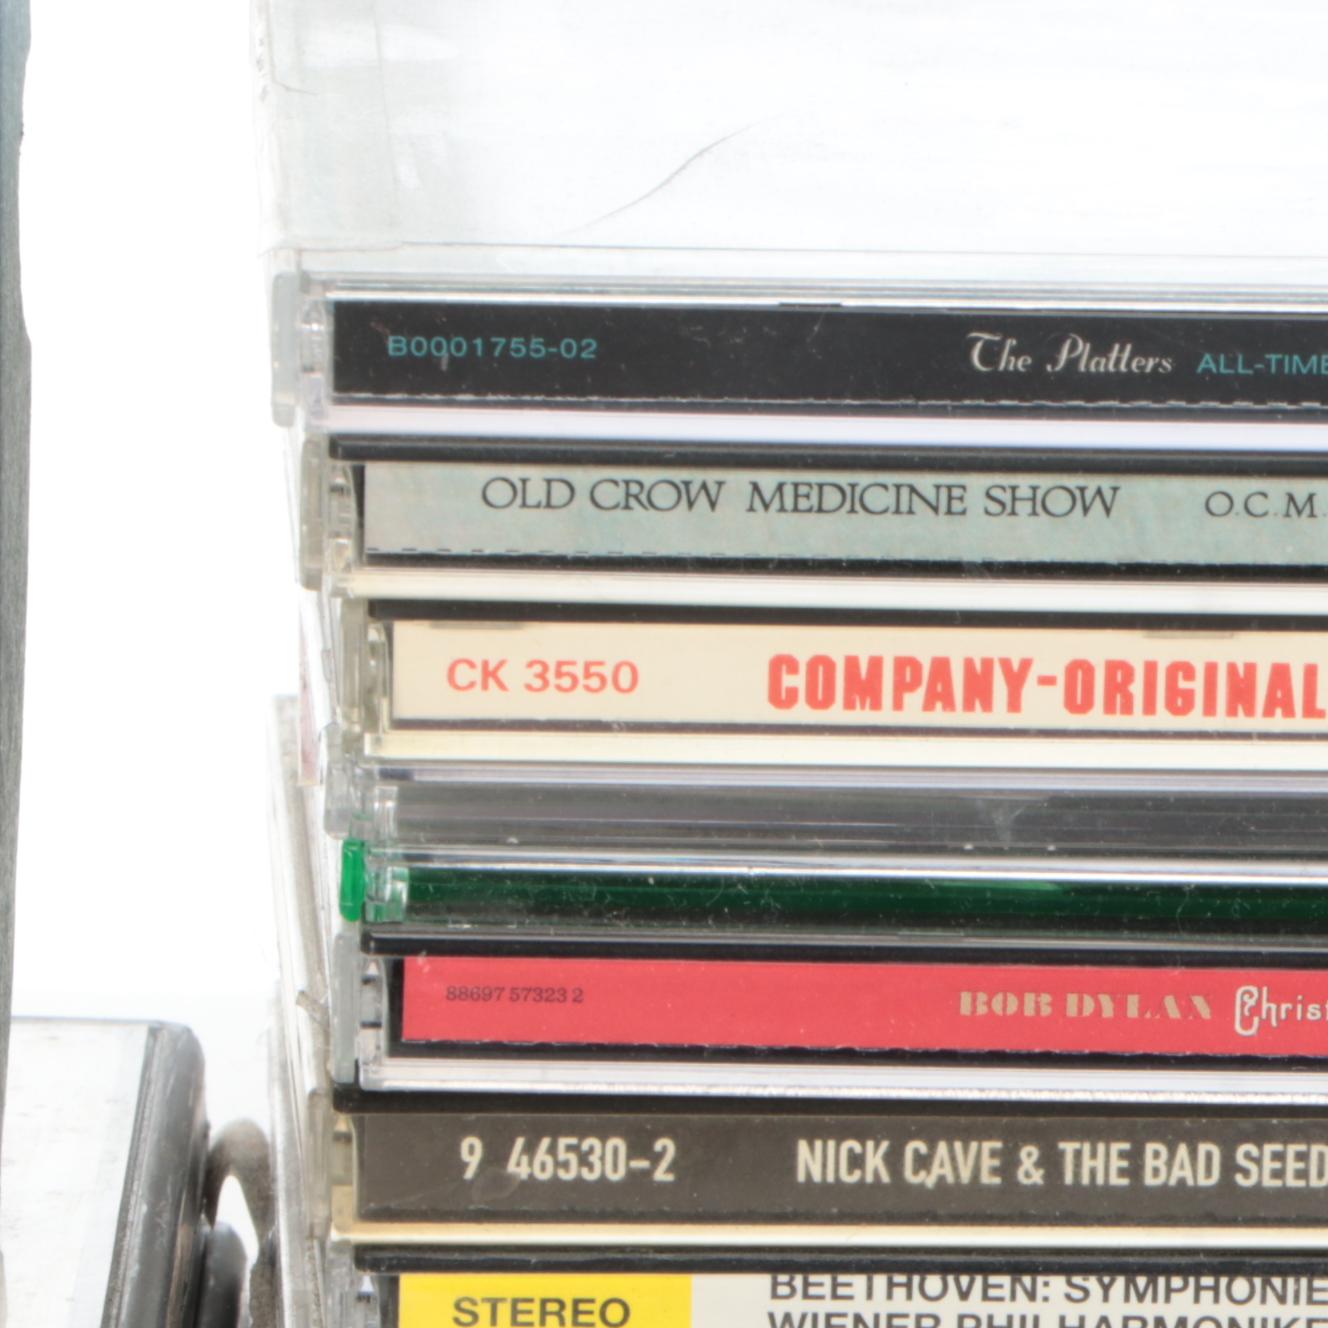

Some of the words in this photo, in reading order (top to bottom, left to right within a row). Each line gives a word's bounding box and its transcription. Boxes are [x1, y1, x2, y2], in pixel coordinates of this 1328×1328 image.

[386, 334, 598, 360] B0001755-02
[967, 331, 1033, 373] The
[1045, 333, 1172, 373] Platters
[481, 476, 577, 510] OLD
[589, 478, 727, 513] CROW
[746, 479, 969, 519] MEDICINE
[983, 476, 1123, 519] SHOW
[446, 658, 509, 692] CK
[524, 658, 639, 694] 3550
[767, 655, 1327, 720] COMPANY-ORIGINAL
[445, 985, 507, 1003] 88697
[503, 985, 568, 1004] 57323
[565, 986, 585, 1005] 2
[959, 991, 1053, 1017] BOB
[1065, 992, 1212, 1020] DYLAN
[460, 1136, 483, 1180] 9
[506, 1136, 676, 1182] 46530-2
[796, 1139, 891, 1184] NICK
[903, 1139, 1003, 1189] CAVE
[1016, 1144, 1045, 1186] &
[1057, 1141, 1131, 1187] THE
[1143, 1142, 1221, 1187] BAD
[768, 1275, 1051, 1303] BEETHOVEN:
[452, 1296, 631, 1328] STEREO
